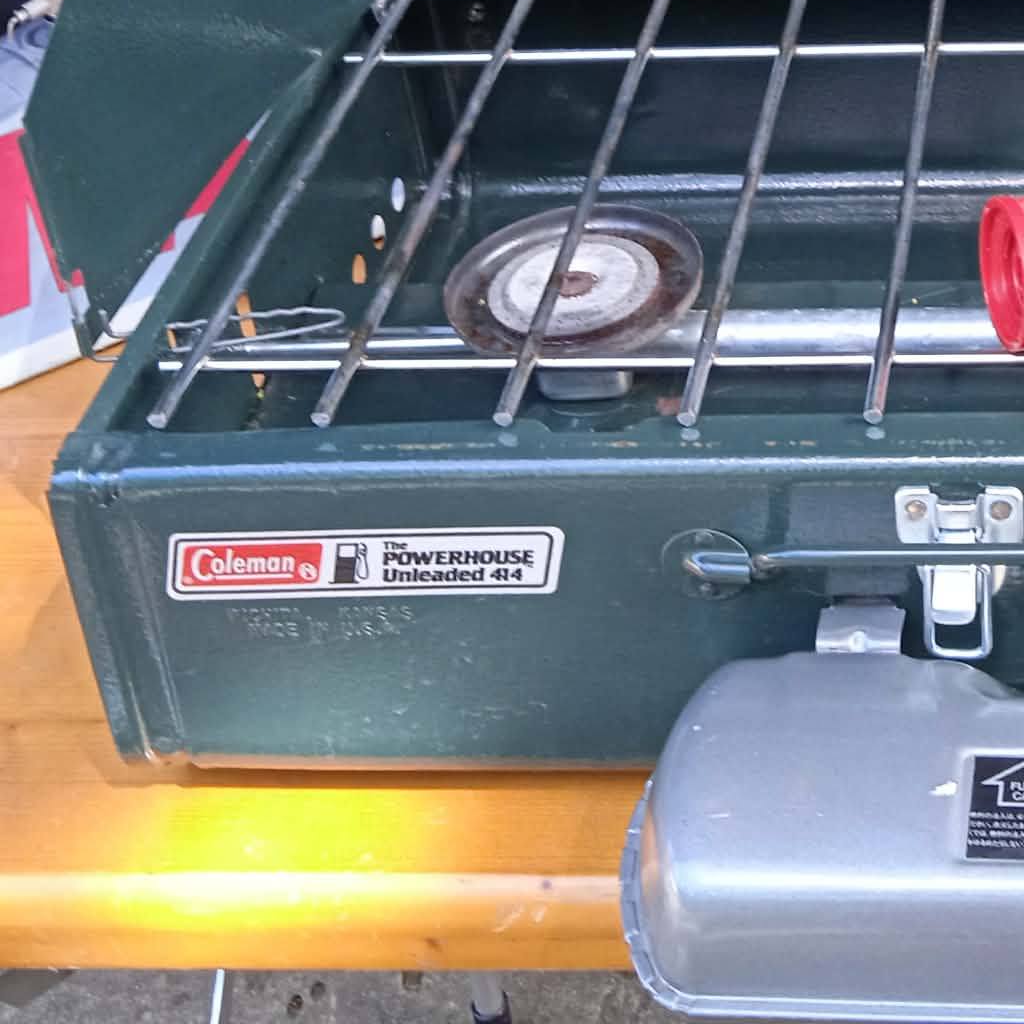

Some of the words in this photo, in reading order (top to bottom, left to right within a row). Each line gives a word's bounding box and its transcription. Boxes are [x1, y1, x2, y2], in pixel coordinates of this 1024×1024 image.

[383, 541, 408, 550] The
[191, 548, 296, 581] Coleman
[382, 550, 534, 566] POWERHOUSE
[382, 567, 485, 582] Unleaded
[489, 568, 523, 582] 414
